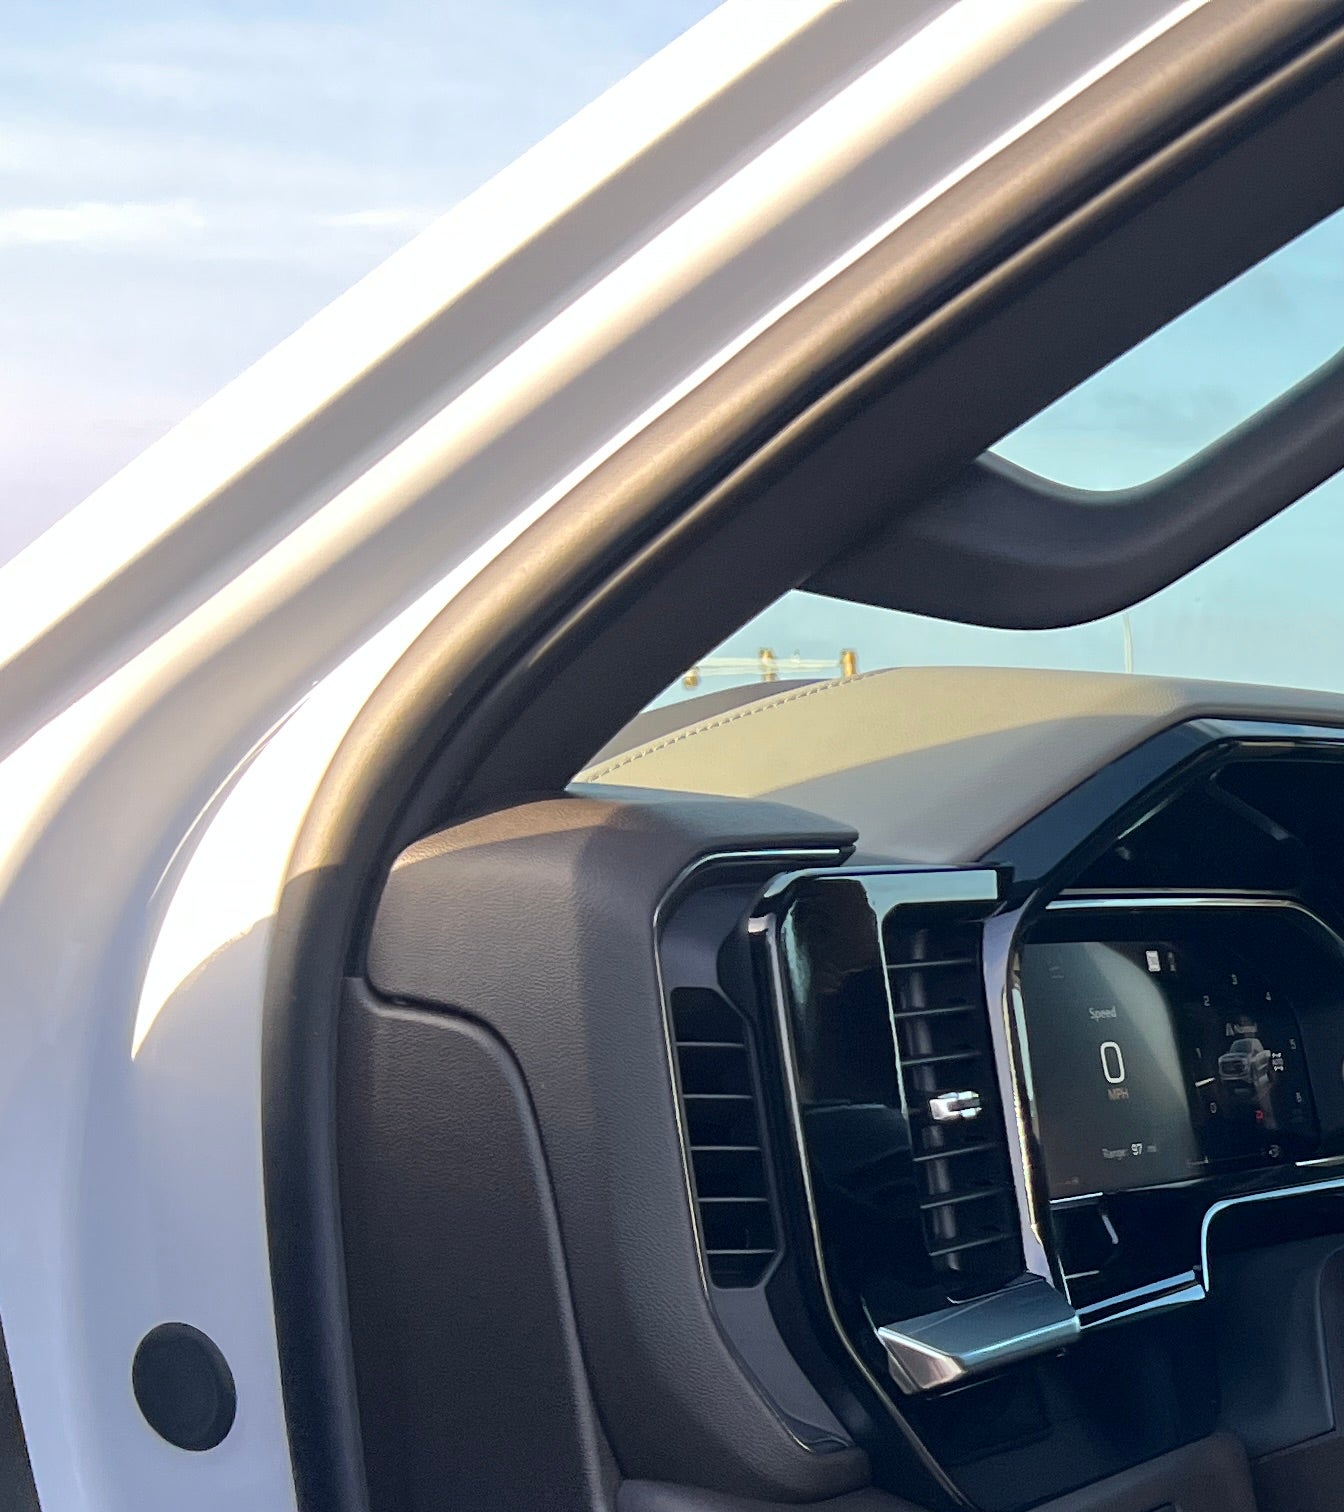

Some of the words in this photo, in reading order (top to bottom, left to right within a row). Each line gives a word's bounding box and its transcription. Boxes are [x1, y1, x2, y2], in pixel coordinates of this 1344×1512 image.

[1088, 1005, 1117, 1022] Speed
[1100, 1041, 1126, 1084] 0
[1107, 1088, 1130, 1101] MPH
